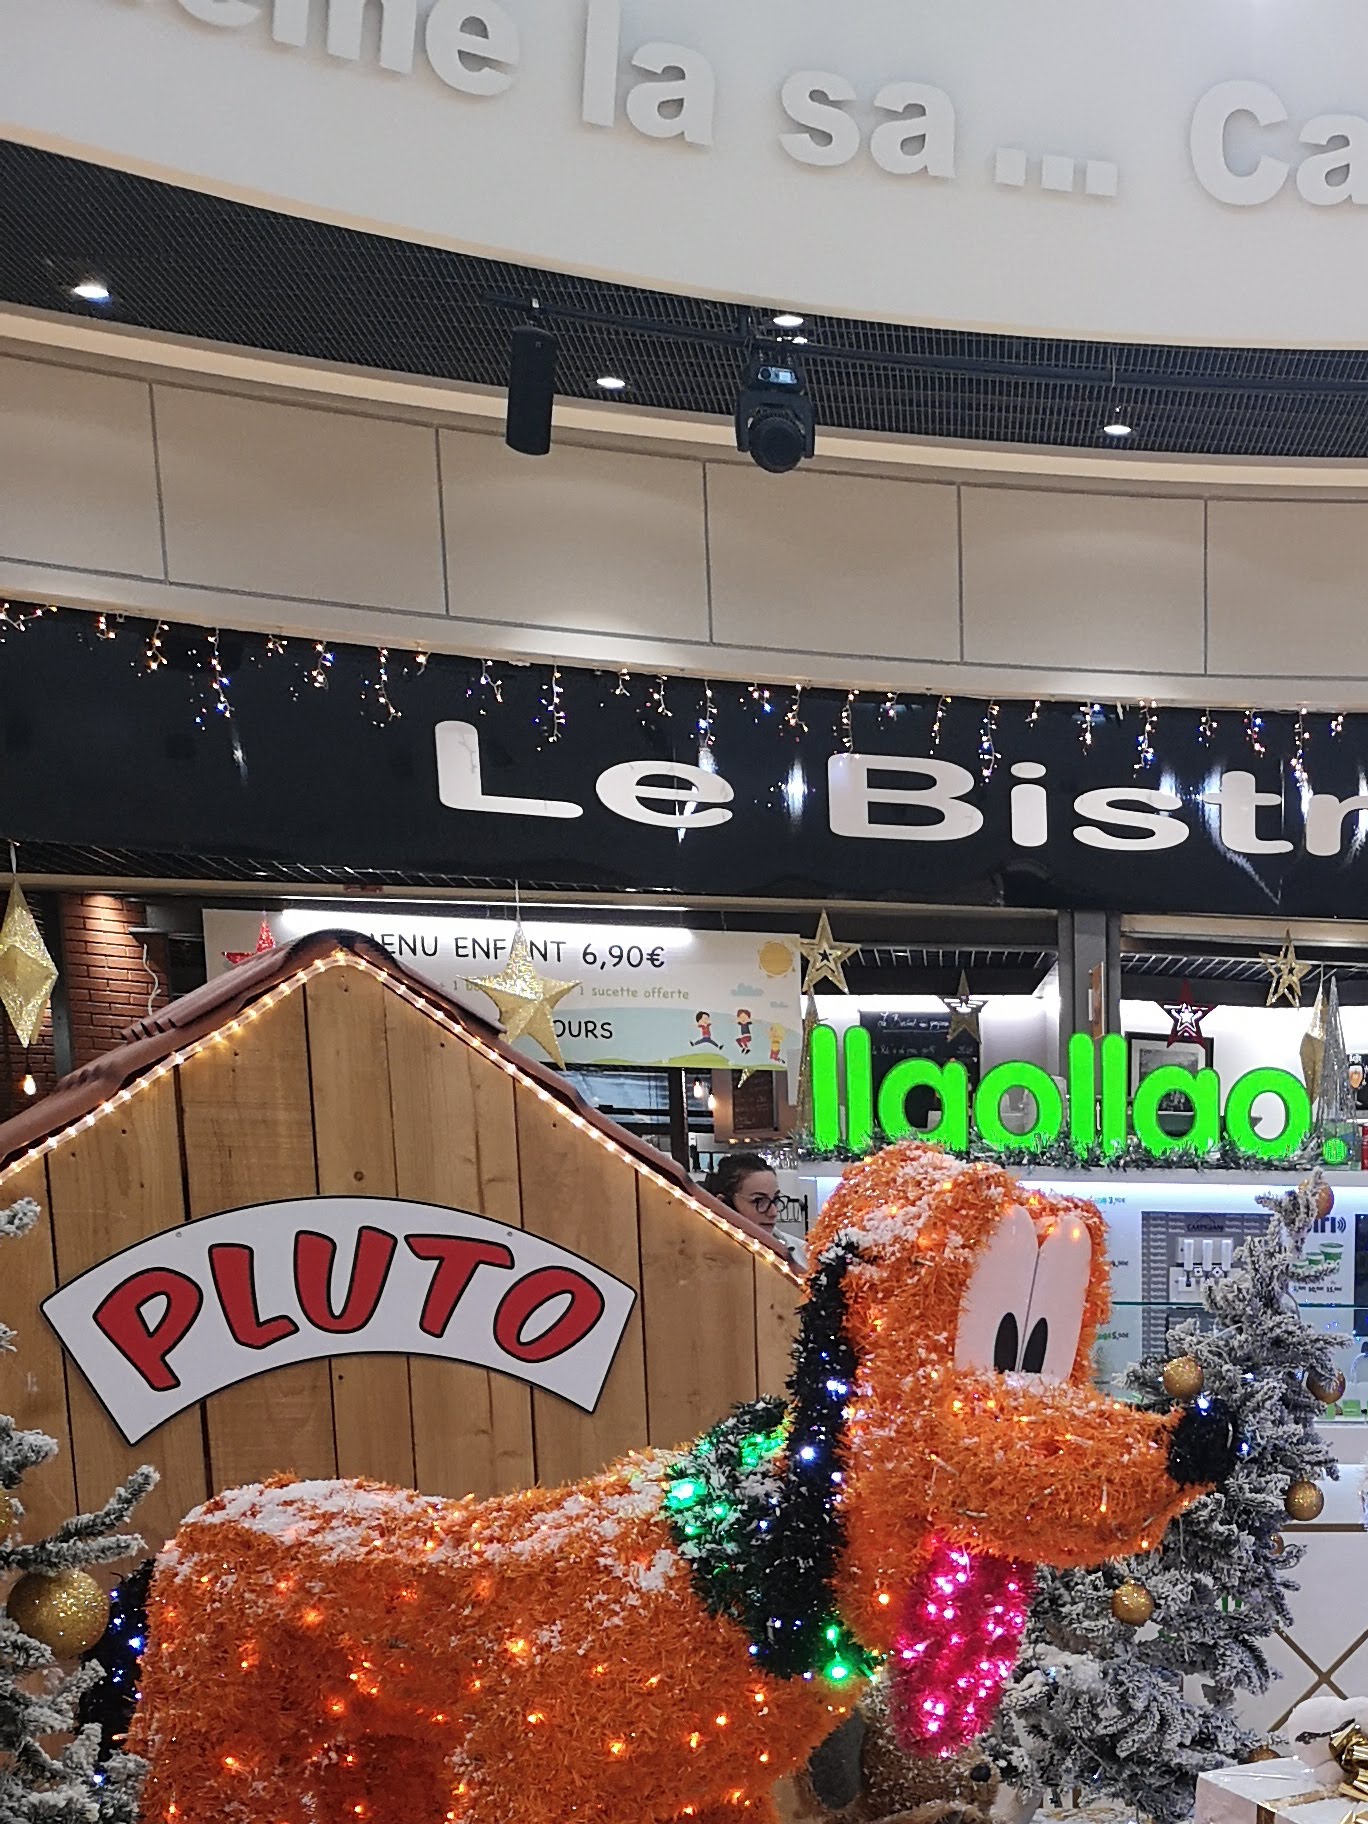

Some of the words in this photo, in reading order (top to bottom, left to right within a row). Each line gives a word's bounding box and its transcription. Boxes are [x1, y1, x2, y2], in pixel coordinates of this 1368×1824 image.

[582, 0, 714, 147] la
[434, 719, 734, 830] Le
[370, 932, 438, 957] ENU
[454, 936, 566, 963] ENFNT
[581, 942, 666, 971] 6,90€
[592, 987, 639, 998] sucette
[644, 988, 690, 1000] offerte
[811, 1024, 1312, 1162] llaollao
[93, 1226, 605, 1391] PLUTO
